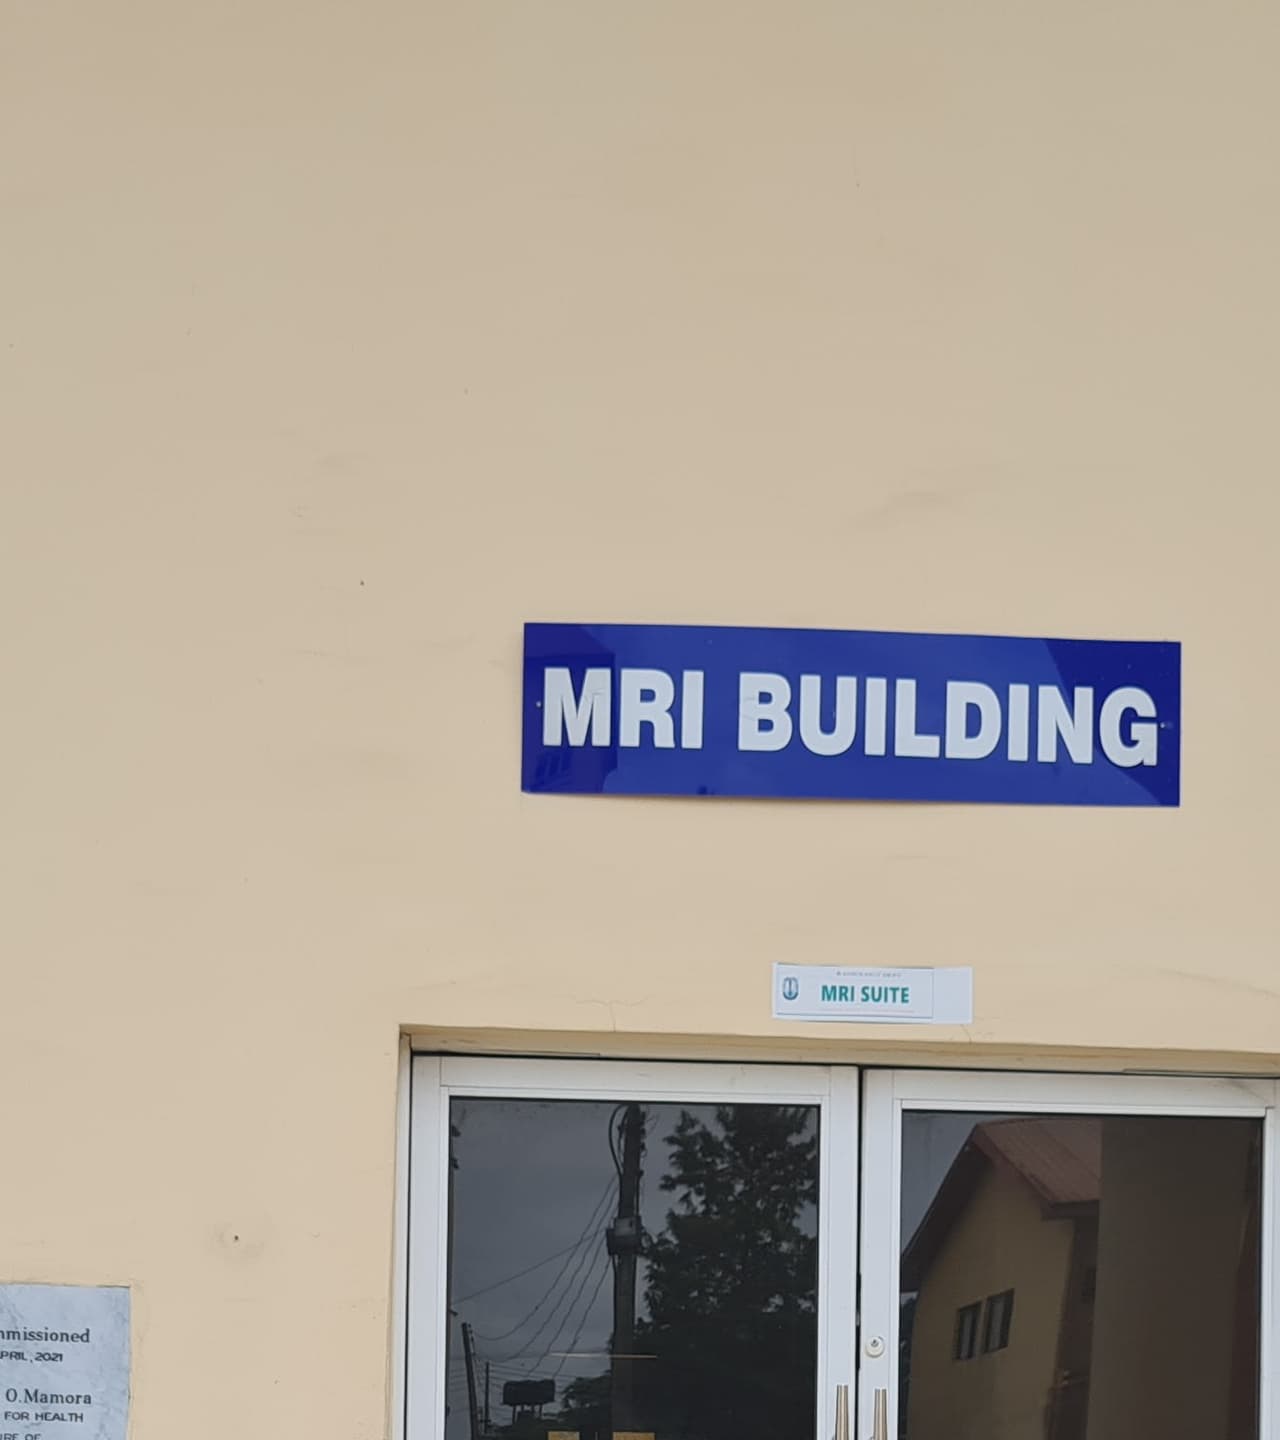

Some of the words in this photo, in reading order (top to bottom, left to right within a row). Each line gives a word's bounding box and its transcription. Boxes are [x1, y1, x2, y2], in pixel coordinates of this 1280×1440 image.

[543, 667, 704, 749] MRI
[738, 671, 1157, 767] BUILDING
[821, 985, 855, 1002] MRI
[861, 986, 909, 1003] SUITE
[5, 1411, 29, 1421] FOR
[35, 1412, 83, 1422] HEALTH
